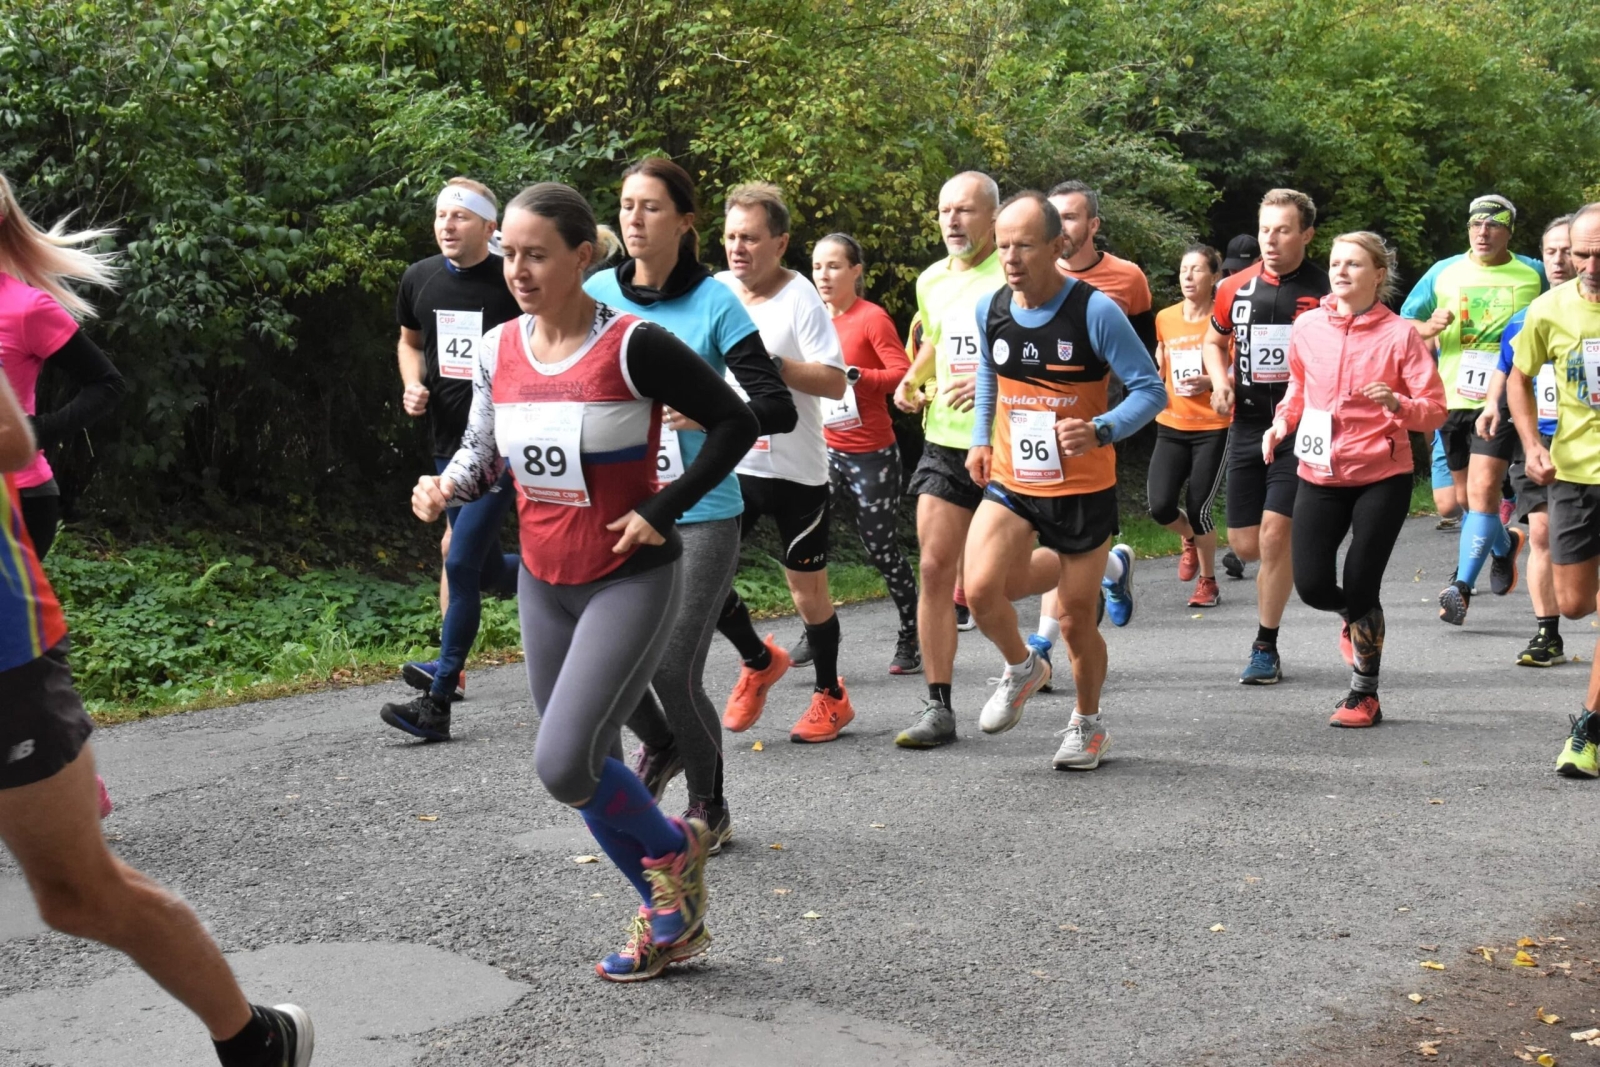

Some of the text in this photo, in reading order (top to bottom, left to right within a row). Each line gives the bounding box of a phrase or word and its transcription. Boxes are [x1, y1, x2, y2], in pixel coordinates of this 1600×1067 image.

[446, 338, 472, 358] 42
[950, 336, 977, 355] 75
[1259, 348, 1285, 365] 29
[1466, 370, 1486, 386] 11
[1544, 387, 1555, 402] 6
[1020, 439, 1049, 461] 96
[1302, 435, 1323, 455] 98
[523, 445, 567, 477] 89
[528, 487, 561, 498] PRIMATOR
